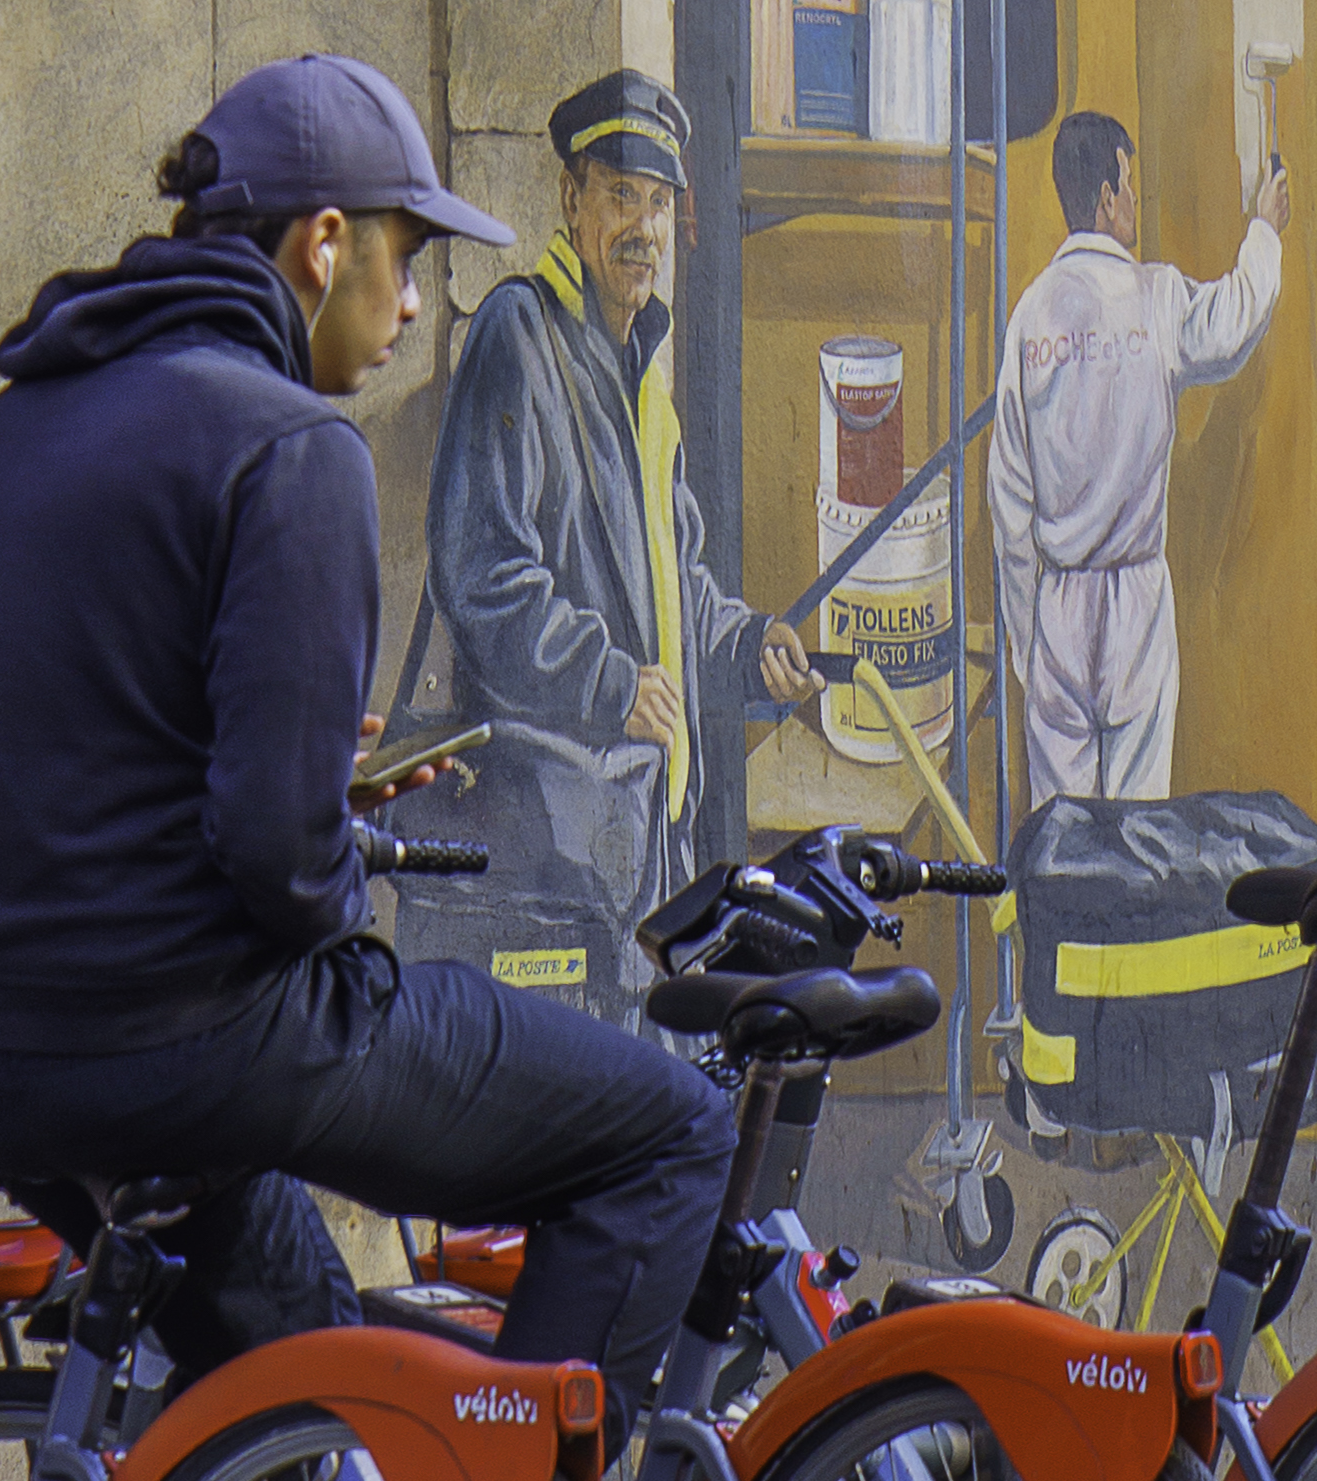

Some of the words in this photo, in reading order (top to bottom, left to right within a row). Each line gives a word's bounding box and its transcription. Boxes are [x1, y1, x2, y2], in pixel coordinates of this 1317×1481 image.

[851, 603, 935, 633] TOLLENS
[854, 641, 908, 666] ELASTO
[914, 639, 935, 664] FIX
[1258, 942, 1274, 959] LA
[497, 962, 514, 977] LA
[517, 960, 561, 976] POSTE
